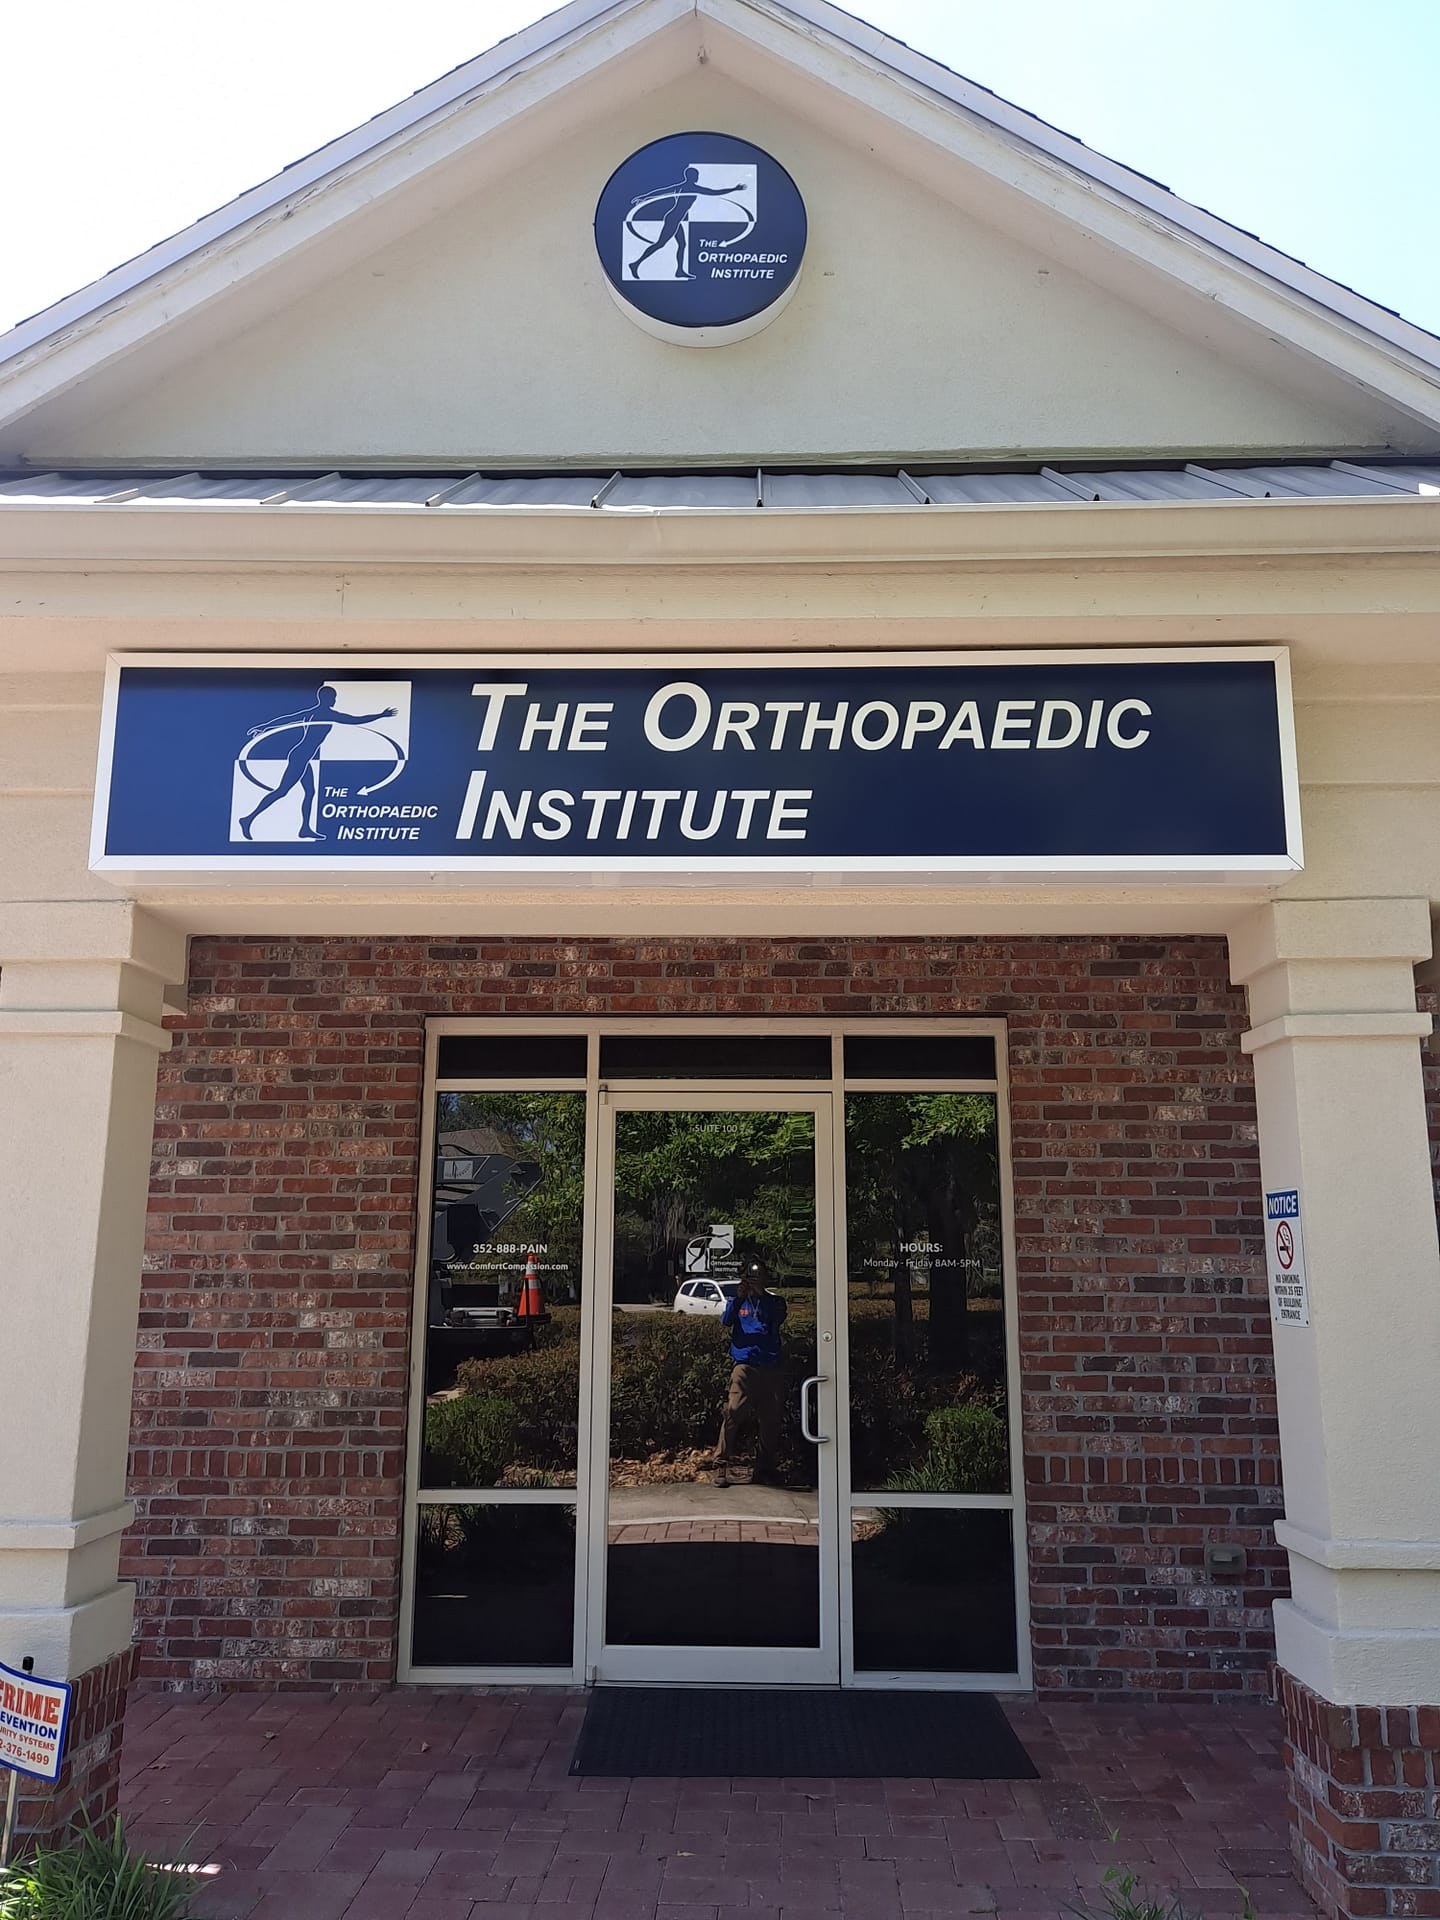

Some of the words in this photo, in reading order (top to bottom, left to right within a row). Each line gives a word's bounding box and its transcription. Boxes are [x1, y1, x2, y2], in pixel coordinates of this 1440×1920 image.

[699, 239, 718, 248] THE
[698, 251, 788, 263] ORTHOPAEDIC
[711, 267, 775, 279] INSTITUTE
[470, 682, 614, 752] THE
[643, 681, 1152, 752] ORTHOPAEDIC
[324, 786, 349, 798] THE
[322, 803, 439, 819] ORTHOPAEDIC
[455, 770, 813, 841] INSTITUTE
[337, 825, 420, 840] INSTITUTE
[695, 1124, 720, 1133] SUITE
[722, 1124, 738, 1133] 100
[1268, 1194, 1297, 1216] NOTICE
[472, 1243, 548, 1254] 352-888-PAIN
[900, 1243, 944, 1253] HOURS:
[446, 1262, 569, 1272] www.ComfortCompassion.com
[863, 1258, 899, 1269] Monday
[906, 1258, 932, 1269] Friday
[935, 1259, 981, 1268] 8AM-5PM
[1294, 1286, 1303, 1296] FEET
[19, 1734, 55, 1752] SYSTEMS
